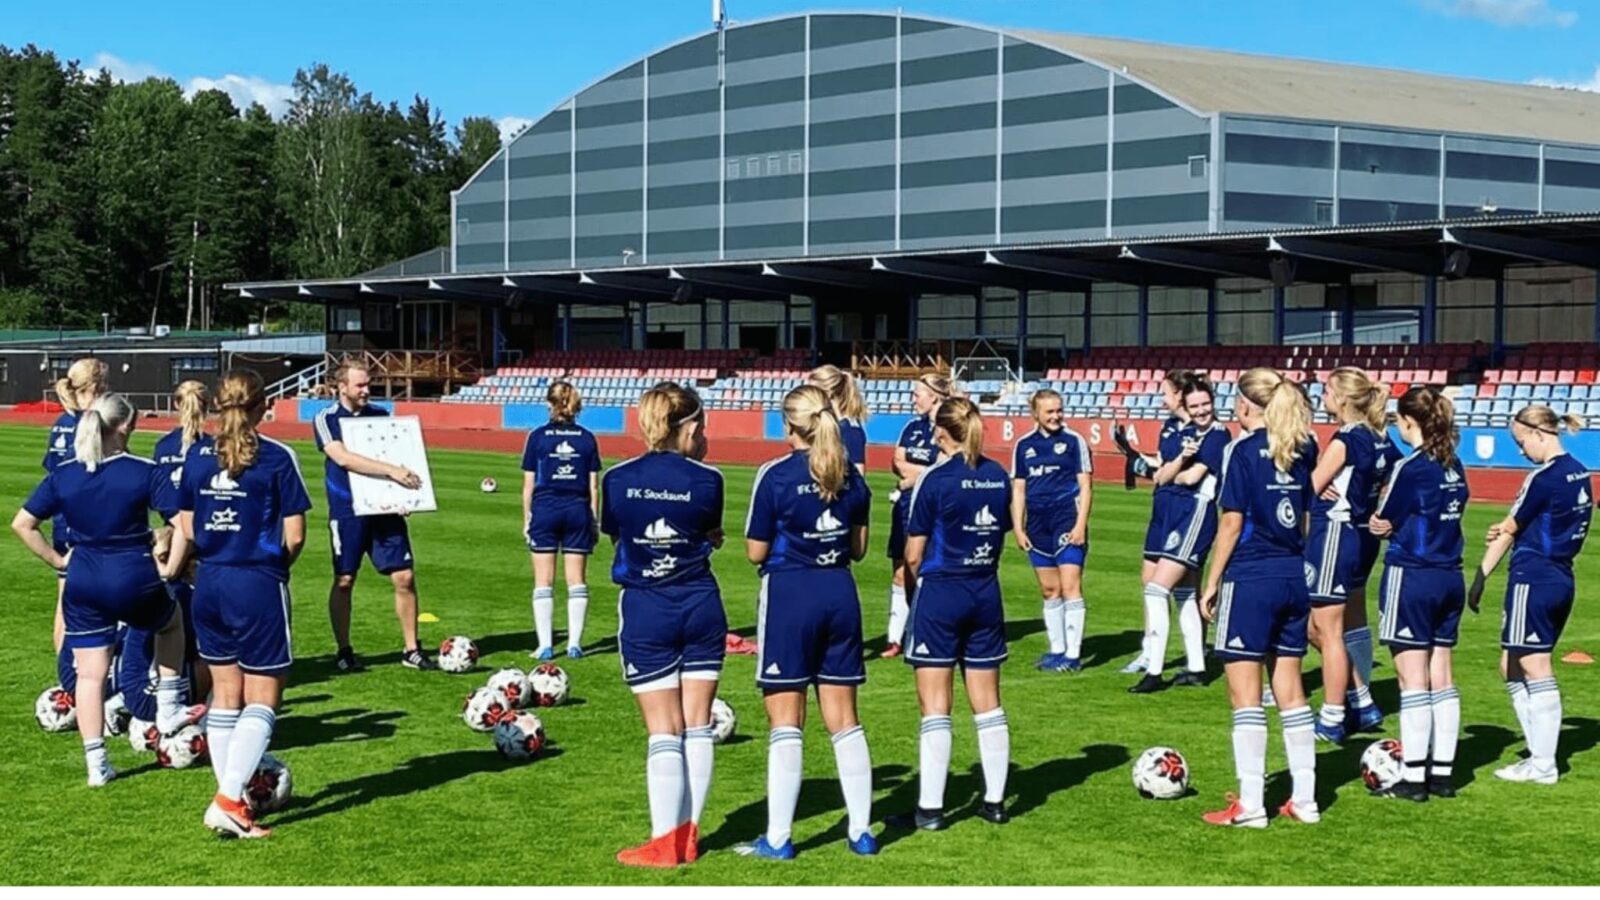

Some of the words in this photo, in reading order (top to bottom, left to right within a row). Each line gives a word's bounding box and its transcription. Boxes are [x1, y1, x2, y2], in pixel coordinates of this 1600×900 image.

[1003, 420, 1014, 441] B
[1090, 422, 1101, 445] S
[1126, 423, 1139, 445] A
[626, 487, 642, 499] IFK
[644, 488, 691, 502] Stocksund
